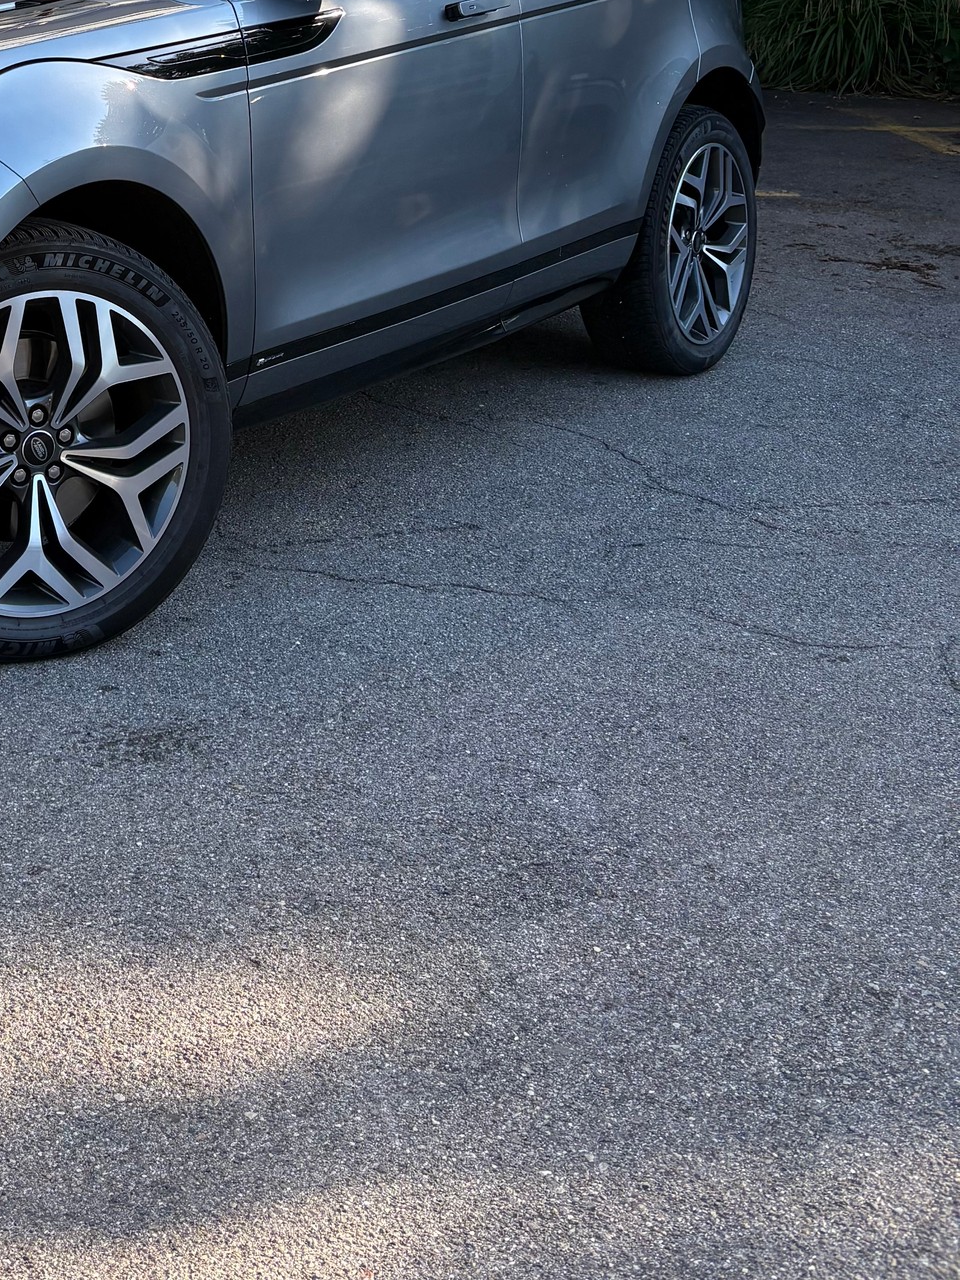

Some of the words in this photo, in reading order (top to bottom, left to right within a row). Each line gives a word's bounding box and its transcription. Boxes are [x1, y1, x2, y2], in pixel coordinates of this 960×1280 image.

[42, 252, 166, 302] MICHELIN
[172, 311, 198, 345] 235/50
[195, 346, 203, 355] R
[200, 357, 210, 371] 20
